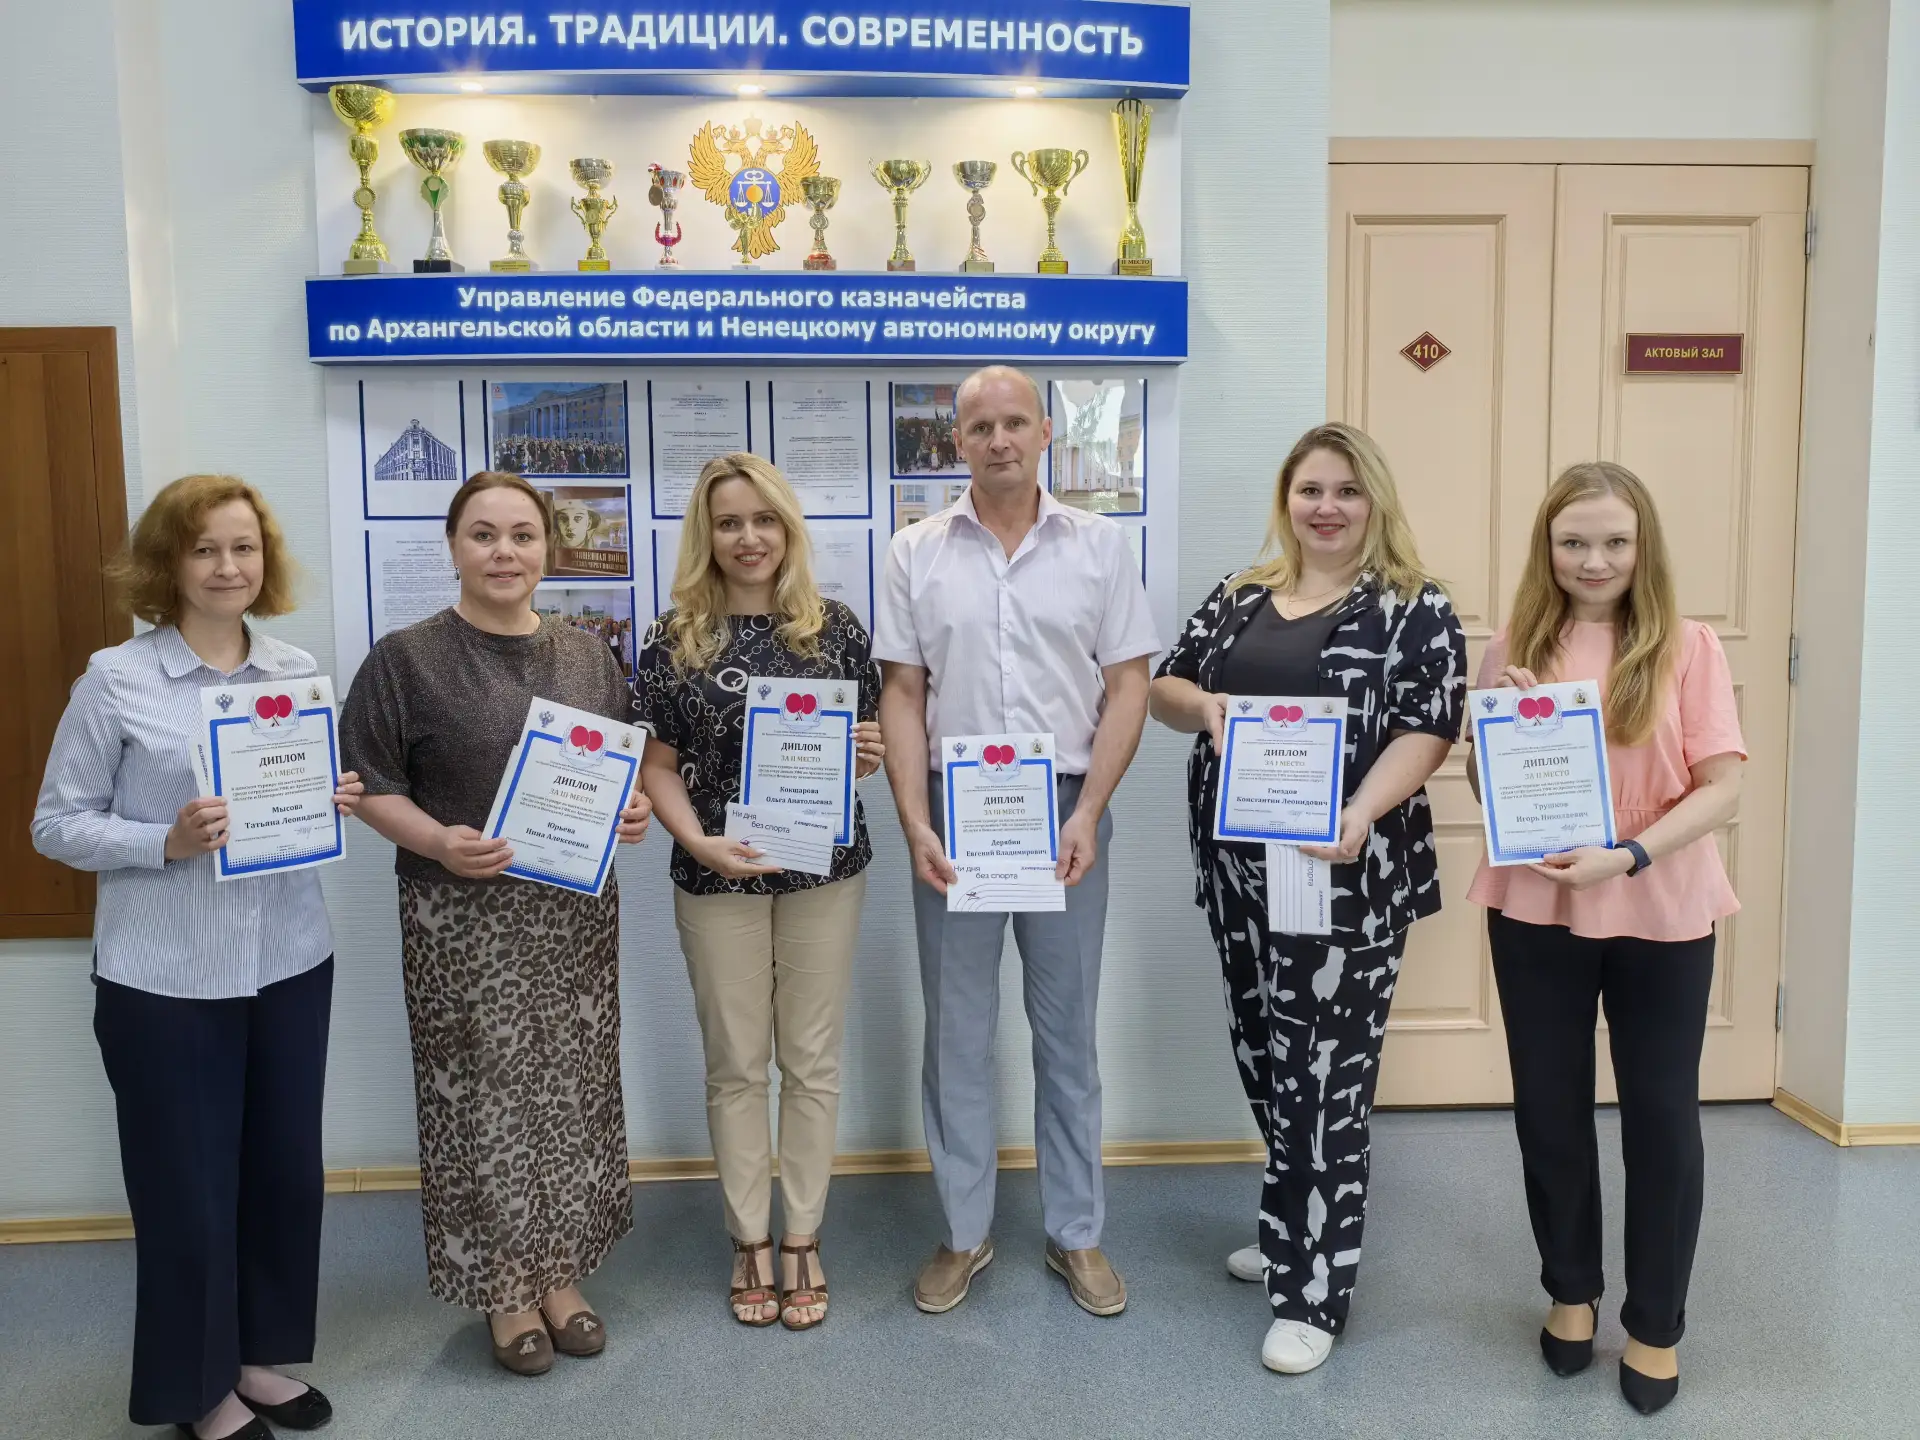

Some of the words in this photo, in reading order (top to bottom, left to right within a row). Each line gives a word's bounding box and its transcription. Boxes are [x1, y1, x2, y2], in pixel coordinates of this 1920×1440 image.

[342, 15, 535, 50] ИСТОРИЯ.
[549, 15, 788, 50] ТРАДИЦИИ.
[802, 15, 1143, 56] СОВРЕМЕННОСТЬ
[458, 287, 625, 311] Управление
[633, 286, 834, 311] Федерального
[841, 285, 1026, 310] казначейства
[329, 324, 361, 342] по
[367, 315, 572, 343] Архангельской
[578, 316, 689, 338] области
[697, 320, 713, 338] и
[721, 316, 876, 342] Ненецкому
[883, 320, 1062, 344] автономному
[1069, 322, 1155, 345] округу
[1413, 344, 1439, 359] 410
[1644, 346, 1699, 358] АКТОВЫЙ
[1701, 347, 1724, 358] ЗАЛ
[781, 742, 822, 752] ДИПЛОМ
[1263, 749, 1307, 757] ДИПЛОМ
[259, 752, 306, 767] ДИПЛОМ
[1523, 756, 1570, 769] ДИПЛОМ
[262, 771, 273, 779] ЗА
[280, 767, 306, 777] МЕСТО
[1543, 769, 1570, 778] МЕСТО
[553, 775, 598, 793] ДИПЛОМ
[549, 788, 559, 796] ЗА
[569, 793, 595, 805] МЕСТО
[780, 786, 819, 795] Кокшарова
[1267, 787, 1298, 795] Гнездов
[766, 796, 786, 804] Ольга
[787, 797, 833, 806] Анатольевна
[983, 796, 1025, 806] ДИПЛОМ
[1236, 796, 1280, 804] Константин
[1281, 798, 1328, 807] Леонидович
[1533, 801, 1569, 811] Трушков
[272, 804, 303, 814] Мысова
[732, 809, 743, 818] Ни
[743, 811, 757, 821] дня
[244, 820, 280, 829] Татьяна
[281, 811, 327, 824] Леонидовна
[1516, 815, 1540, 824] Игорь
[1541, 811, 1588, 821] Николаевич
[547, 821, 576, 835] Юрьева
[751, 821, 765, 829] без
[765, 824, 791, 834] спорта
[525, 827, 546, 838] Нина
[546, 833, 589, 850] Алексеевна
[991, 839, 1021, 847] Дерябин
[966, 849, 995, 857] Евгений
[995, 849, 1047, 858] Владимирович
[965, 865, 981, 873] дня
[990, 873, 1018, 881] спорта
